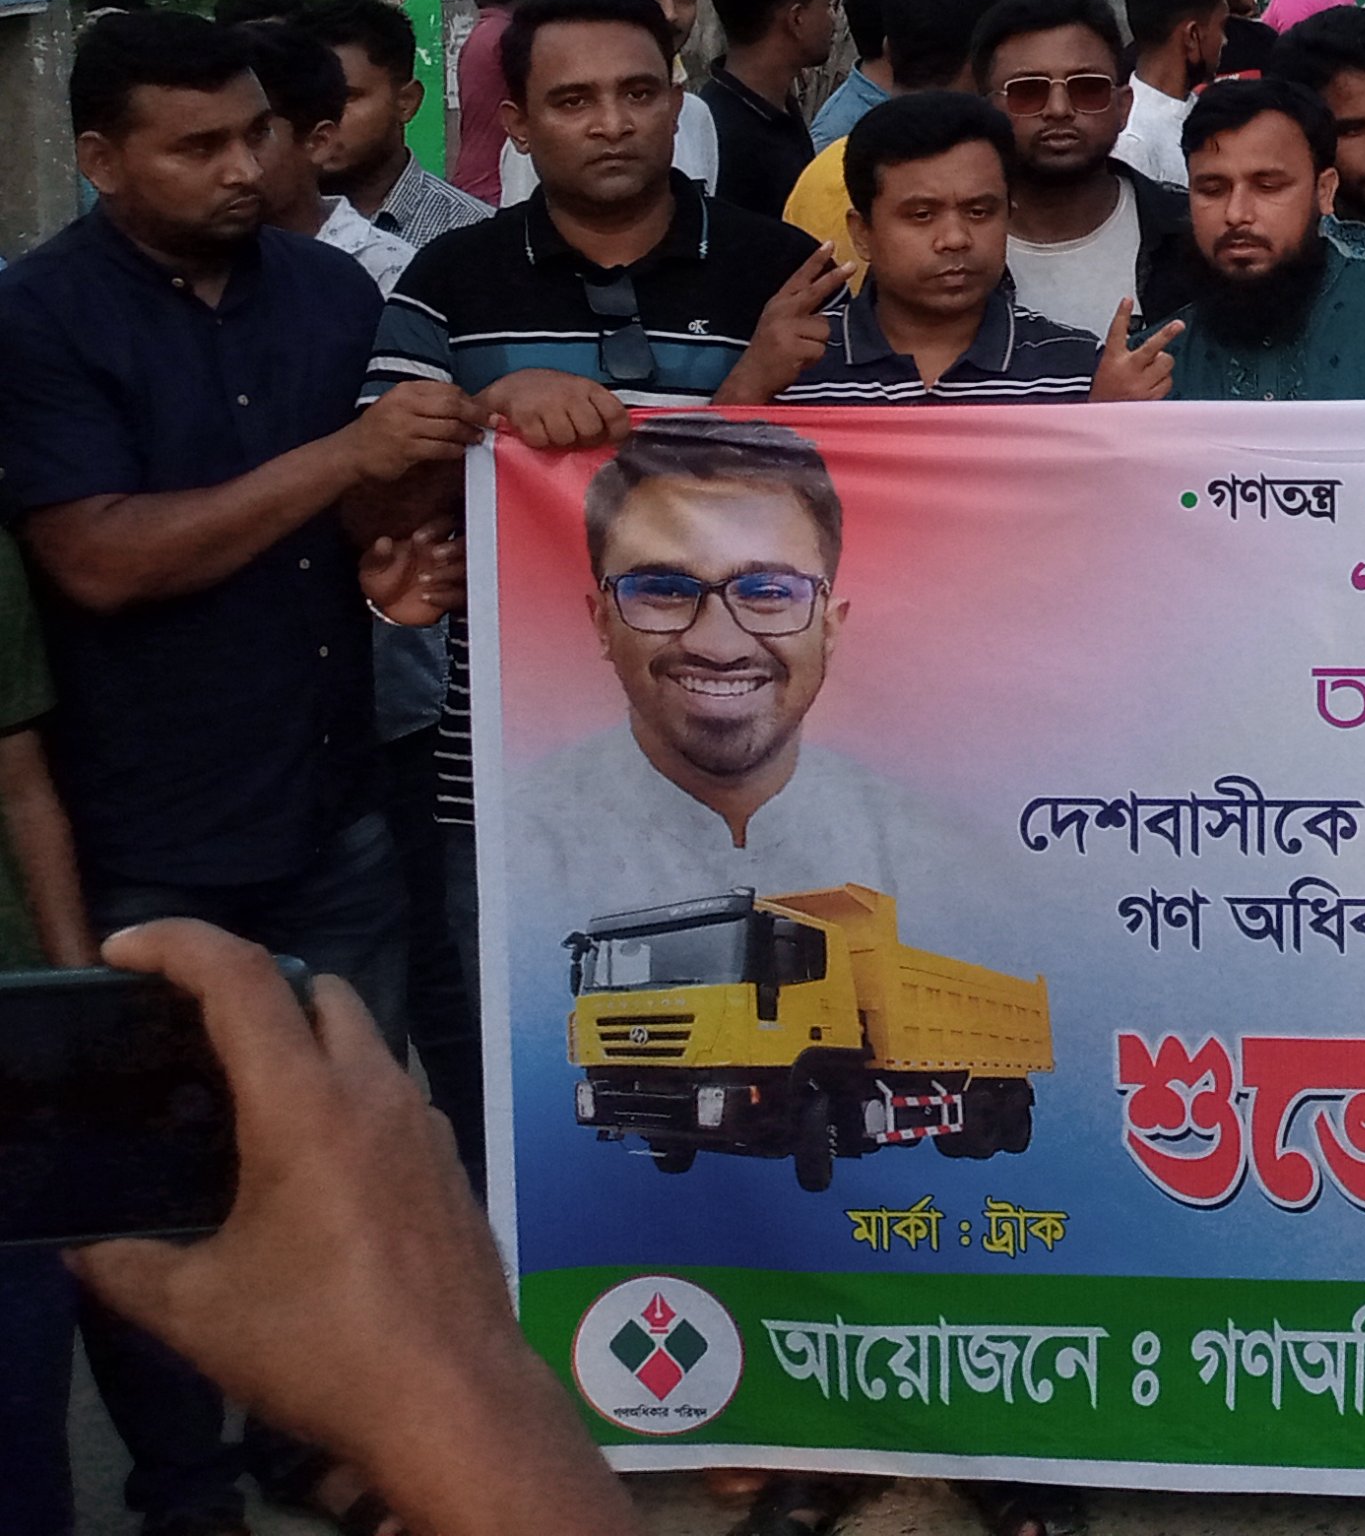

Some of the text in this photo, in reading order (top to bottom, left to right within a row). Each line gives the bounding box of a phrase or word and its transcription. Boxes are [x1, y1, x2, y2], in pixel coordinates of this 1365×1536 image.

[1208, 472, 1343, 524] গণতন্ত্র
[1018, 775, 1365, 858] দেশবাসীকে
[1118, 886, 1209, 952] গণ
[845, 1195, 945, 1252] মার্কা
[982, 1196, 1070, 1258] ট্রাক
[761, 1314, 1110, 1409] আয়োজনে
